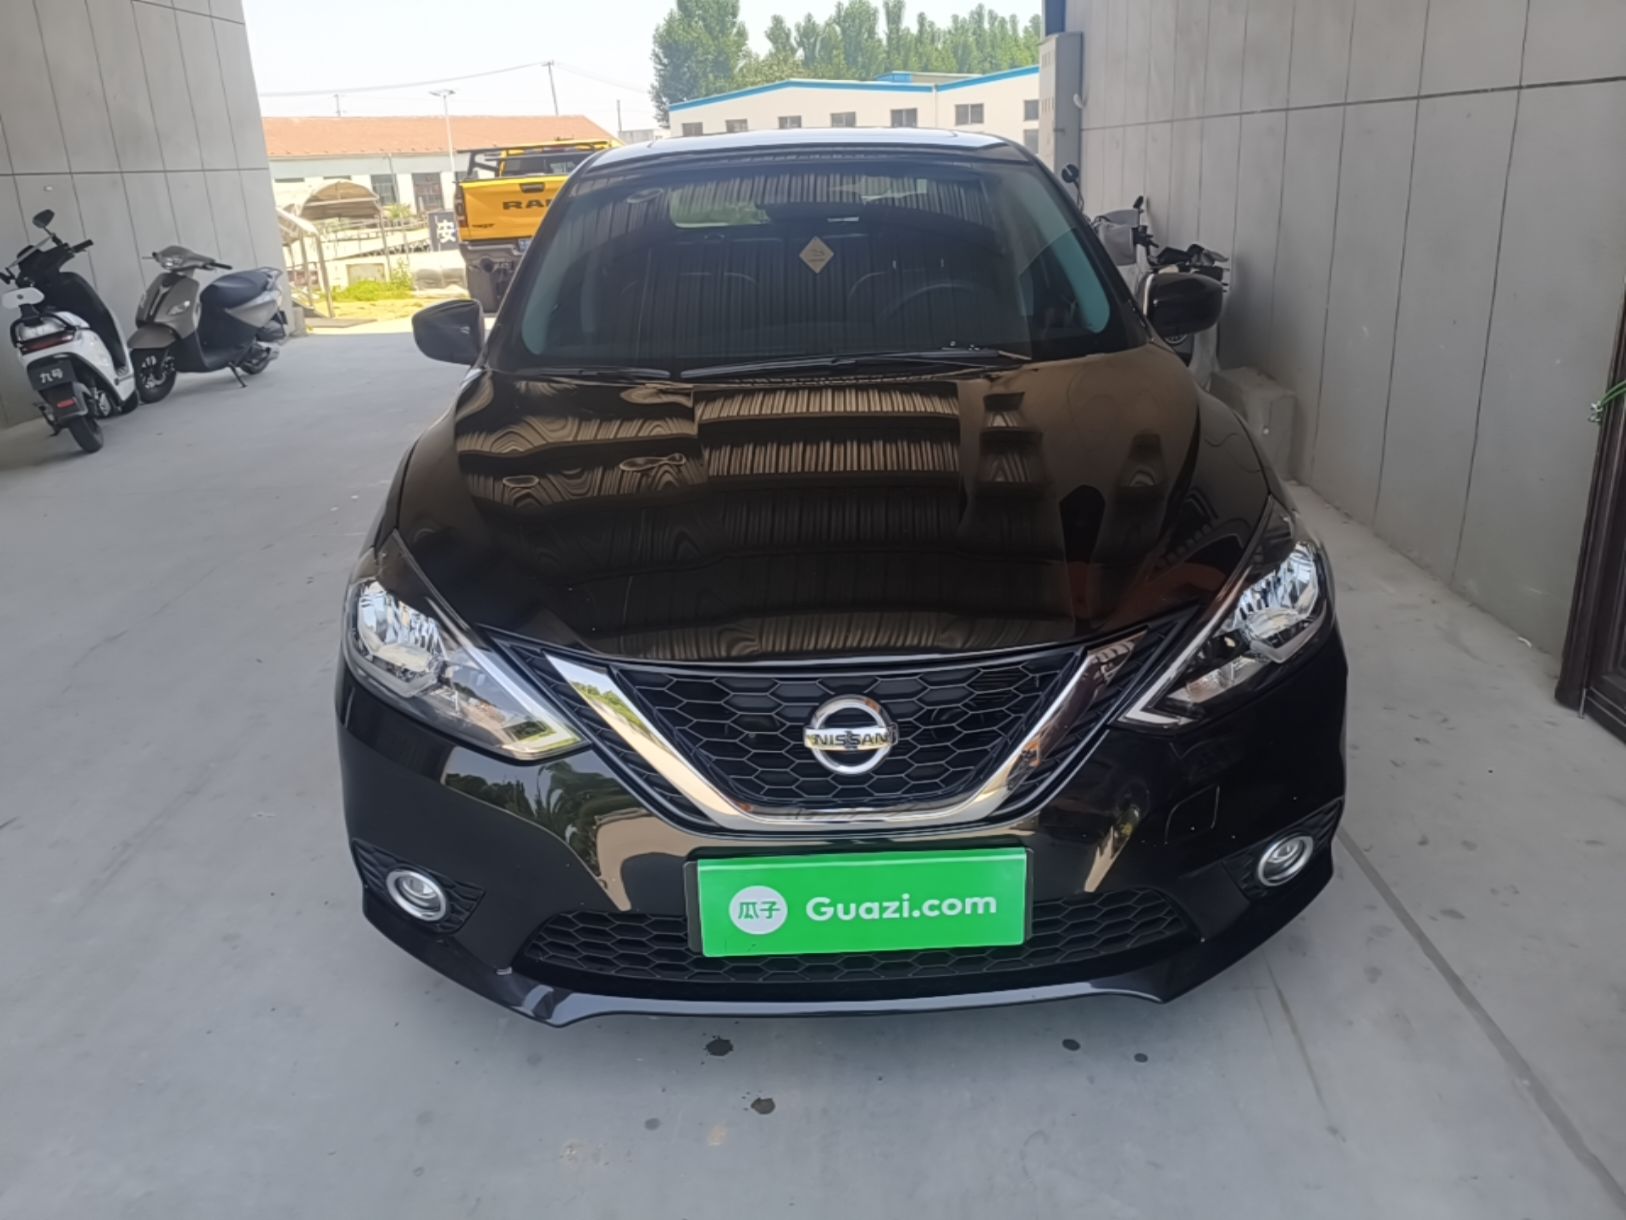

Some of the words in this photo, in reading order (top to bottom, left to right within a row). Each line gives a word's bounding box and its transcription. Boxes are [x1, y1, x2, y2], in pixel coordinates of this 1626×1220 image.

[436, 219, 457, 243] 安
[814, 732, 888, 746] NISSAN
[738, 901, 780, 919] 瓜子
[805, 893, 997, 922] Guazi.com
